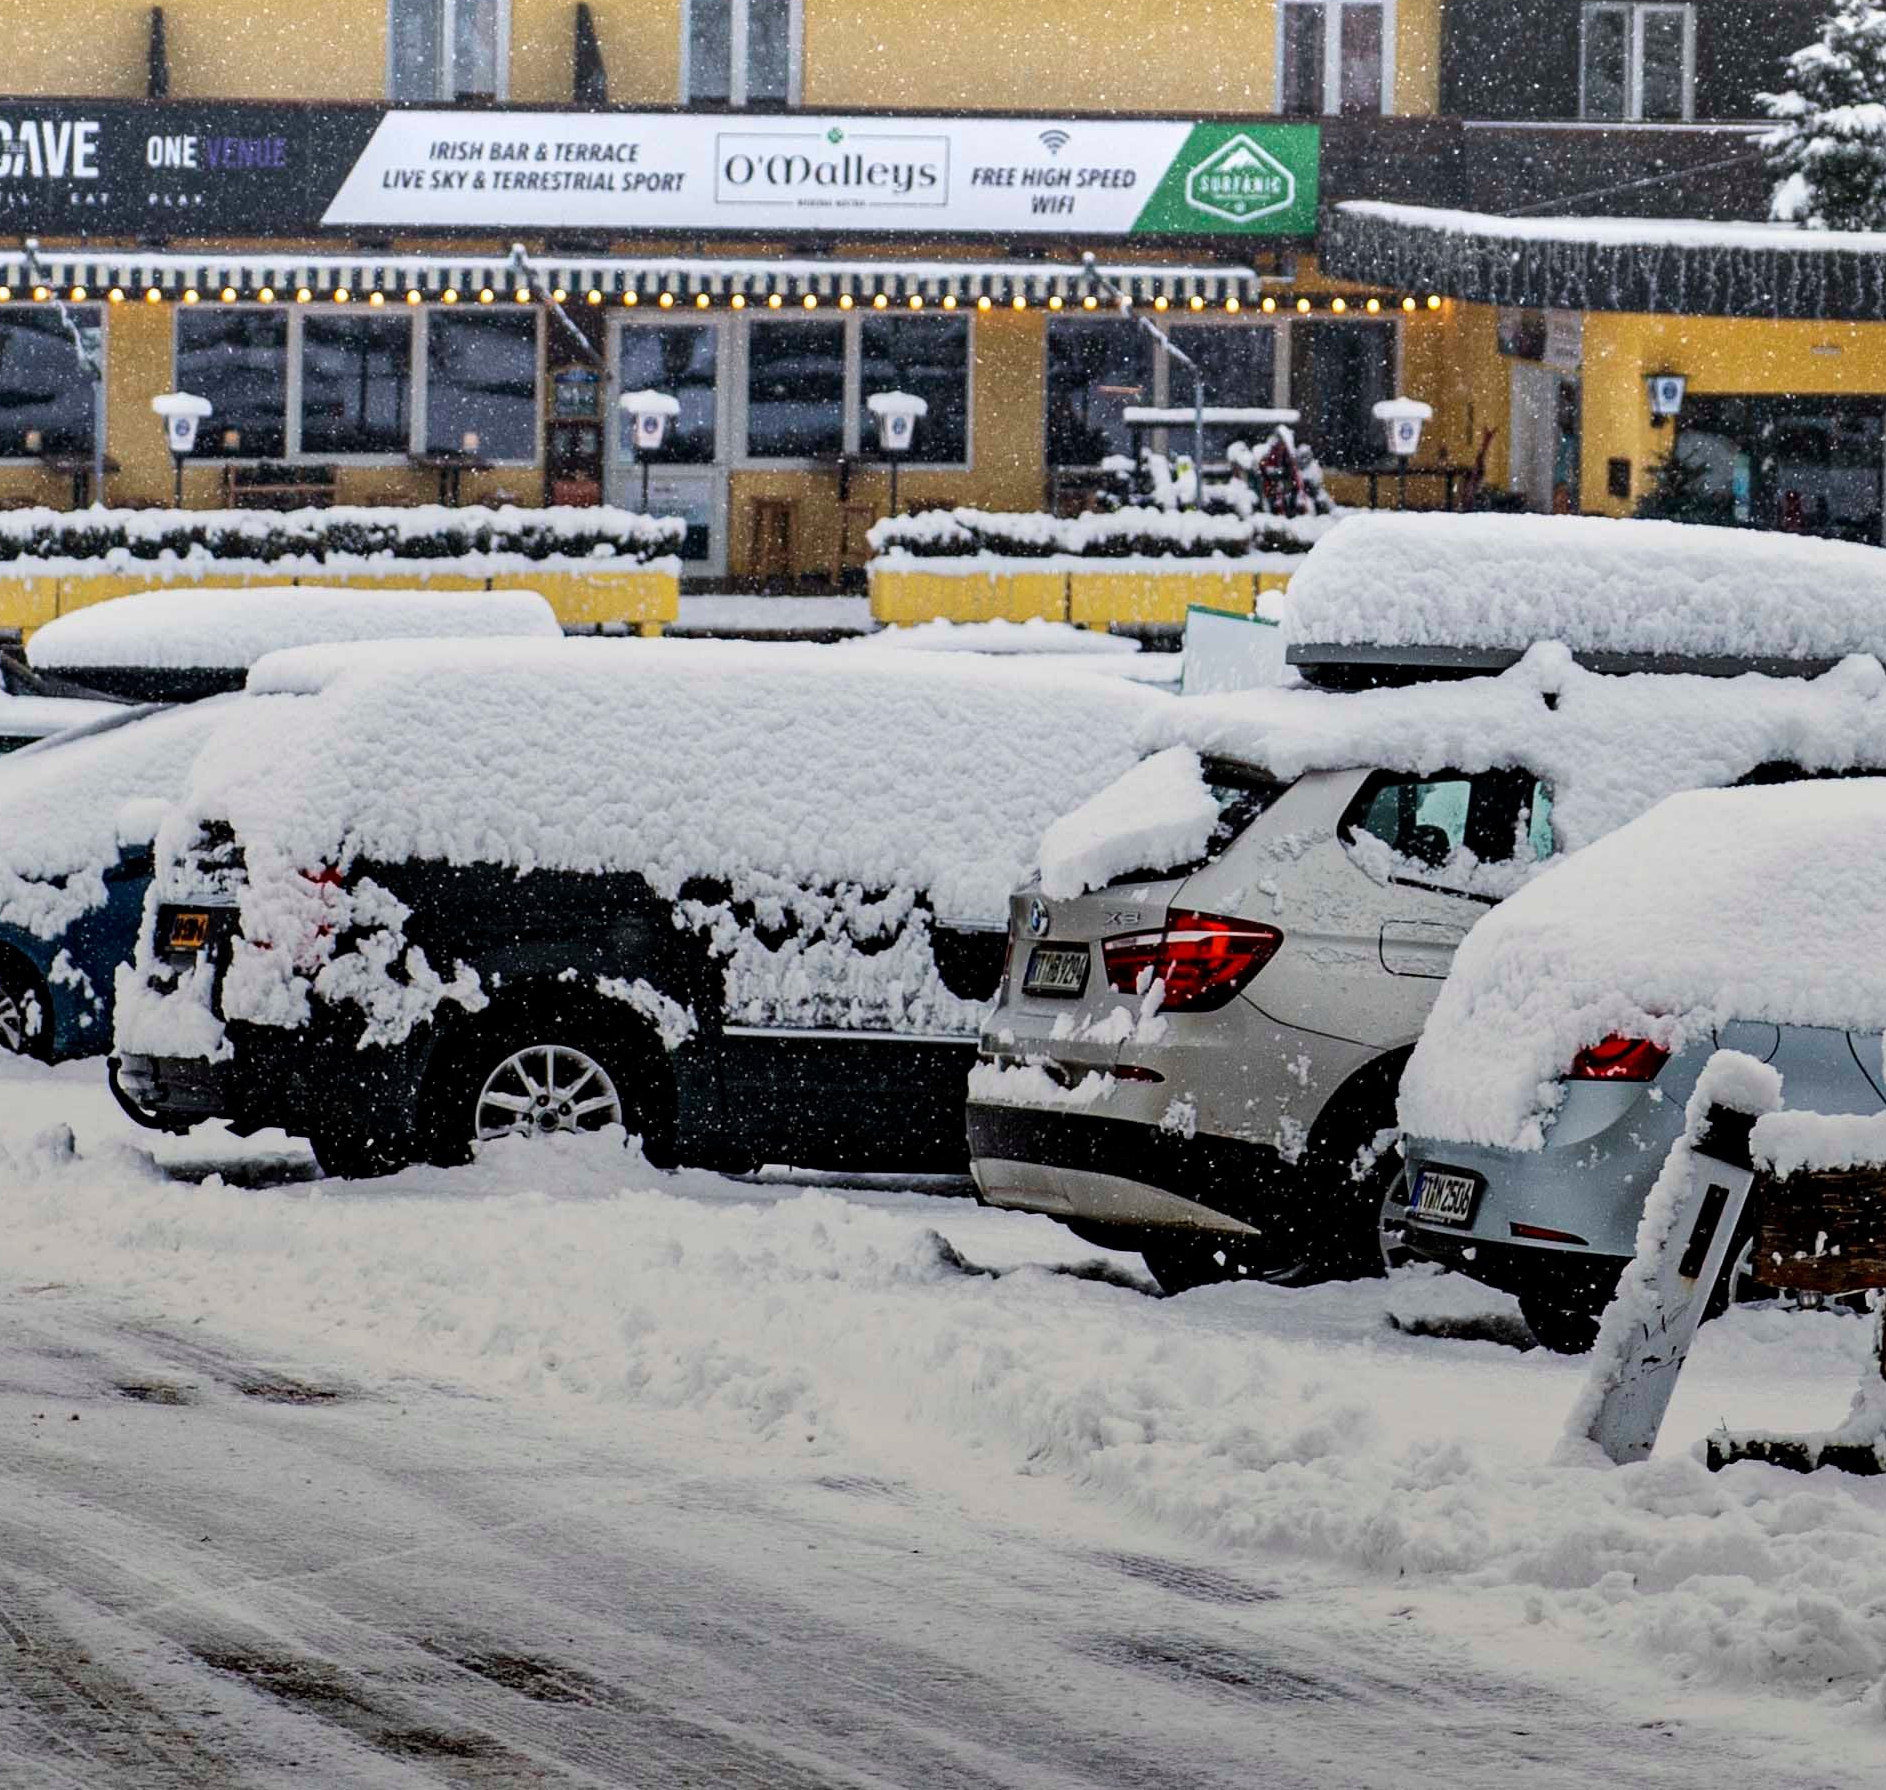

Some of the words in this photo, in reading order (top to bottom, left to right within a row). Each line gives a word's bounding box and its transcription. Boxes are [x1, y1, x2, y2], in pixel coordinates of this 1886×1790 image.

[146, 134, 199, 169] ONE
[205, 136, 287, 168] VENUE
[429, 141, 484, 162] IRISH
[489, 142, 531, 162] BAR
[534, 143, 547, 162] &
[555, 142, 640, 163] TERRACE
[382, 170, 425, 190] LIVE
[429, 170, 469, 190] SKY
[472, 171, 487, 191] &
[492, 171, 615, 192] TERRESTRIAL
[621, 171, 686, 193] SPORT
[724, 153, 938, 194] O'Malleys
[971, 167, 1017, 188] FREE
[1021, 167, 1072, 188] HIGH
[1075, 167, 1138, 190] SPEED
[1200, 174, 1282, 195] SURFANIC
[70, 191, 111, 205] EAT
[147, 192, 203, 206] PLAY
[1031, 194, 1076, 215] WIFI
